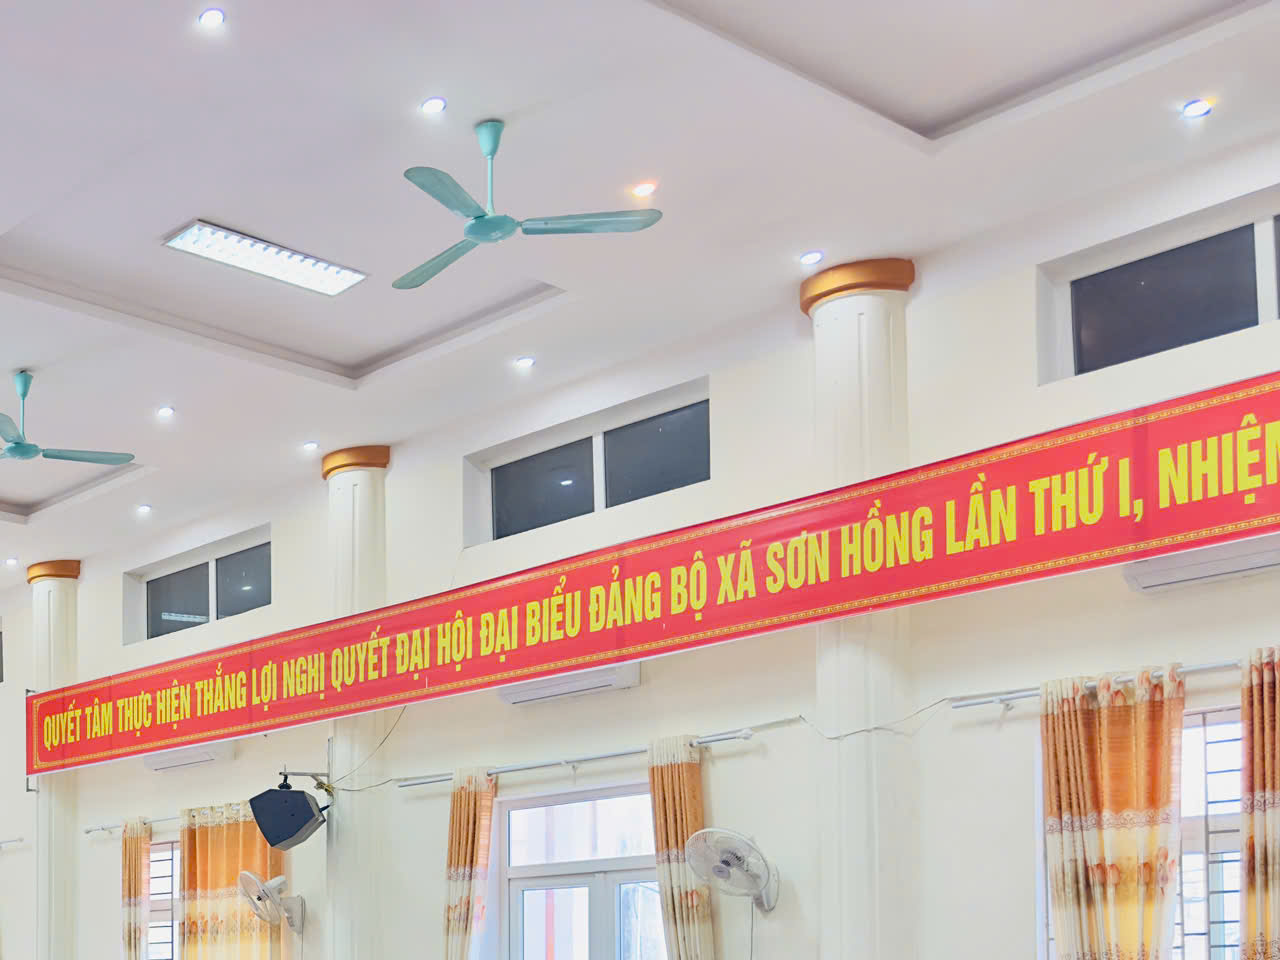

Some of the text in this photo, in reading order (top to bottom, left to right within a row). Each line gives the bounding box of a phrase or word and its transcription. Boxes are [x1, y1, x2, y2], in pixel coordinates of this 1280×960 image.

[44, 700, 81, 750] QUYẾT
[86, 698, 112, 738] TÂM
[117, 691, 152, 736] THỰC
[157, 680, 190, 729] HIỆN
[196, 663, 246, 716] THẮNG
[252, 662, 277, 711] LỢI
[284, 653, 324, 699] NGHỊ
[332, 626, 390, 691] QUYẾT
[396, 628, 430, 680] ĐẠI
[438, 611, 472, 671] HỘI
[480, 606, 518, 662] ĐẠI
[526, 576, 580, 646] BIỂU
[589, 566, 661, 632] ĐẢNG
[670, 552, 706, 620] BỘ
[718, 540, 756, 604] XÃ
[766, 531, 829, 592] SƠN
[842, 500, 933, 576] HỒNG
[946, 473, 1016, 554] LẦN
[1029, 453, 1108, 535] THỨ
[1120, 458, 1143, 521] I,
